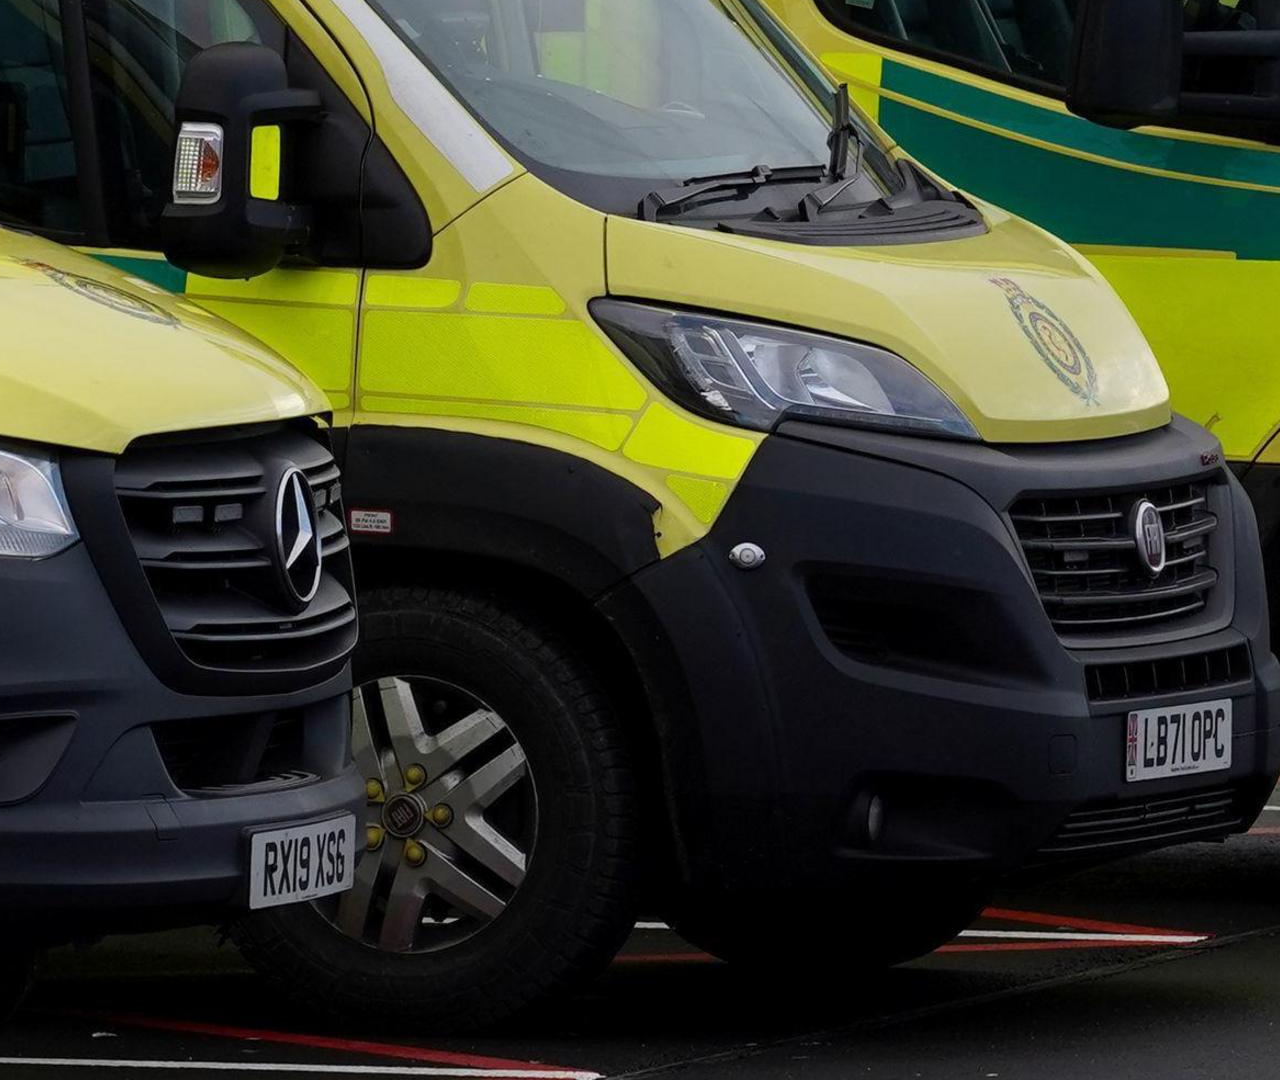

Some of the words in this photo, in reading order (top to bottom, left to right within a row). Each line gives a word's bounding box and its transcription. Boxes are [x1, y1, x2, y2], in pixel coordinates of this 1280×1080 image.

[1143, 713, 1187, 768] LB71
[1191, 708, 1225, 762] OPC
[263, 837, 311, 897] RX19
